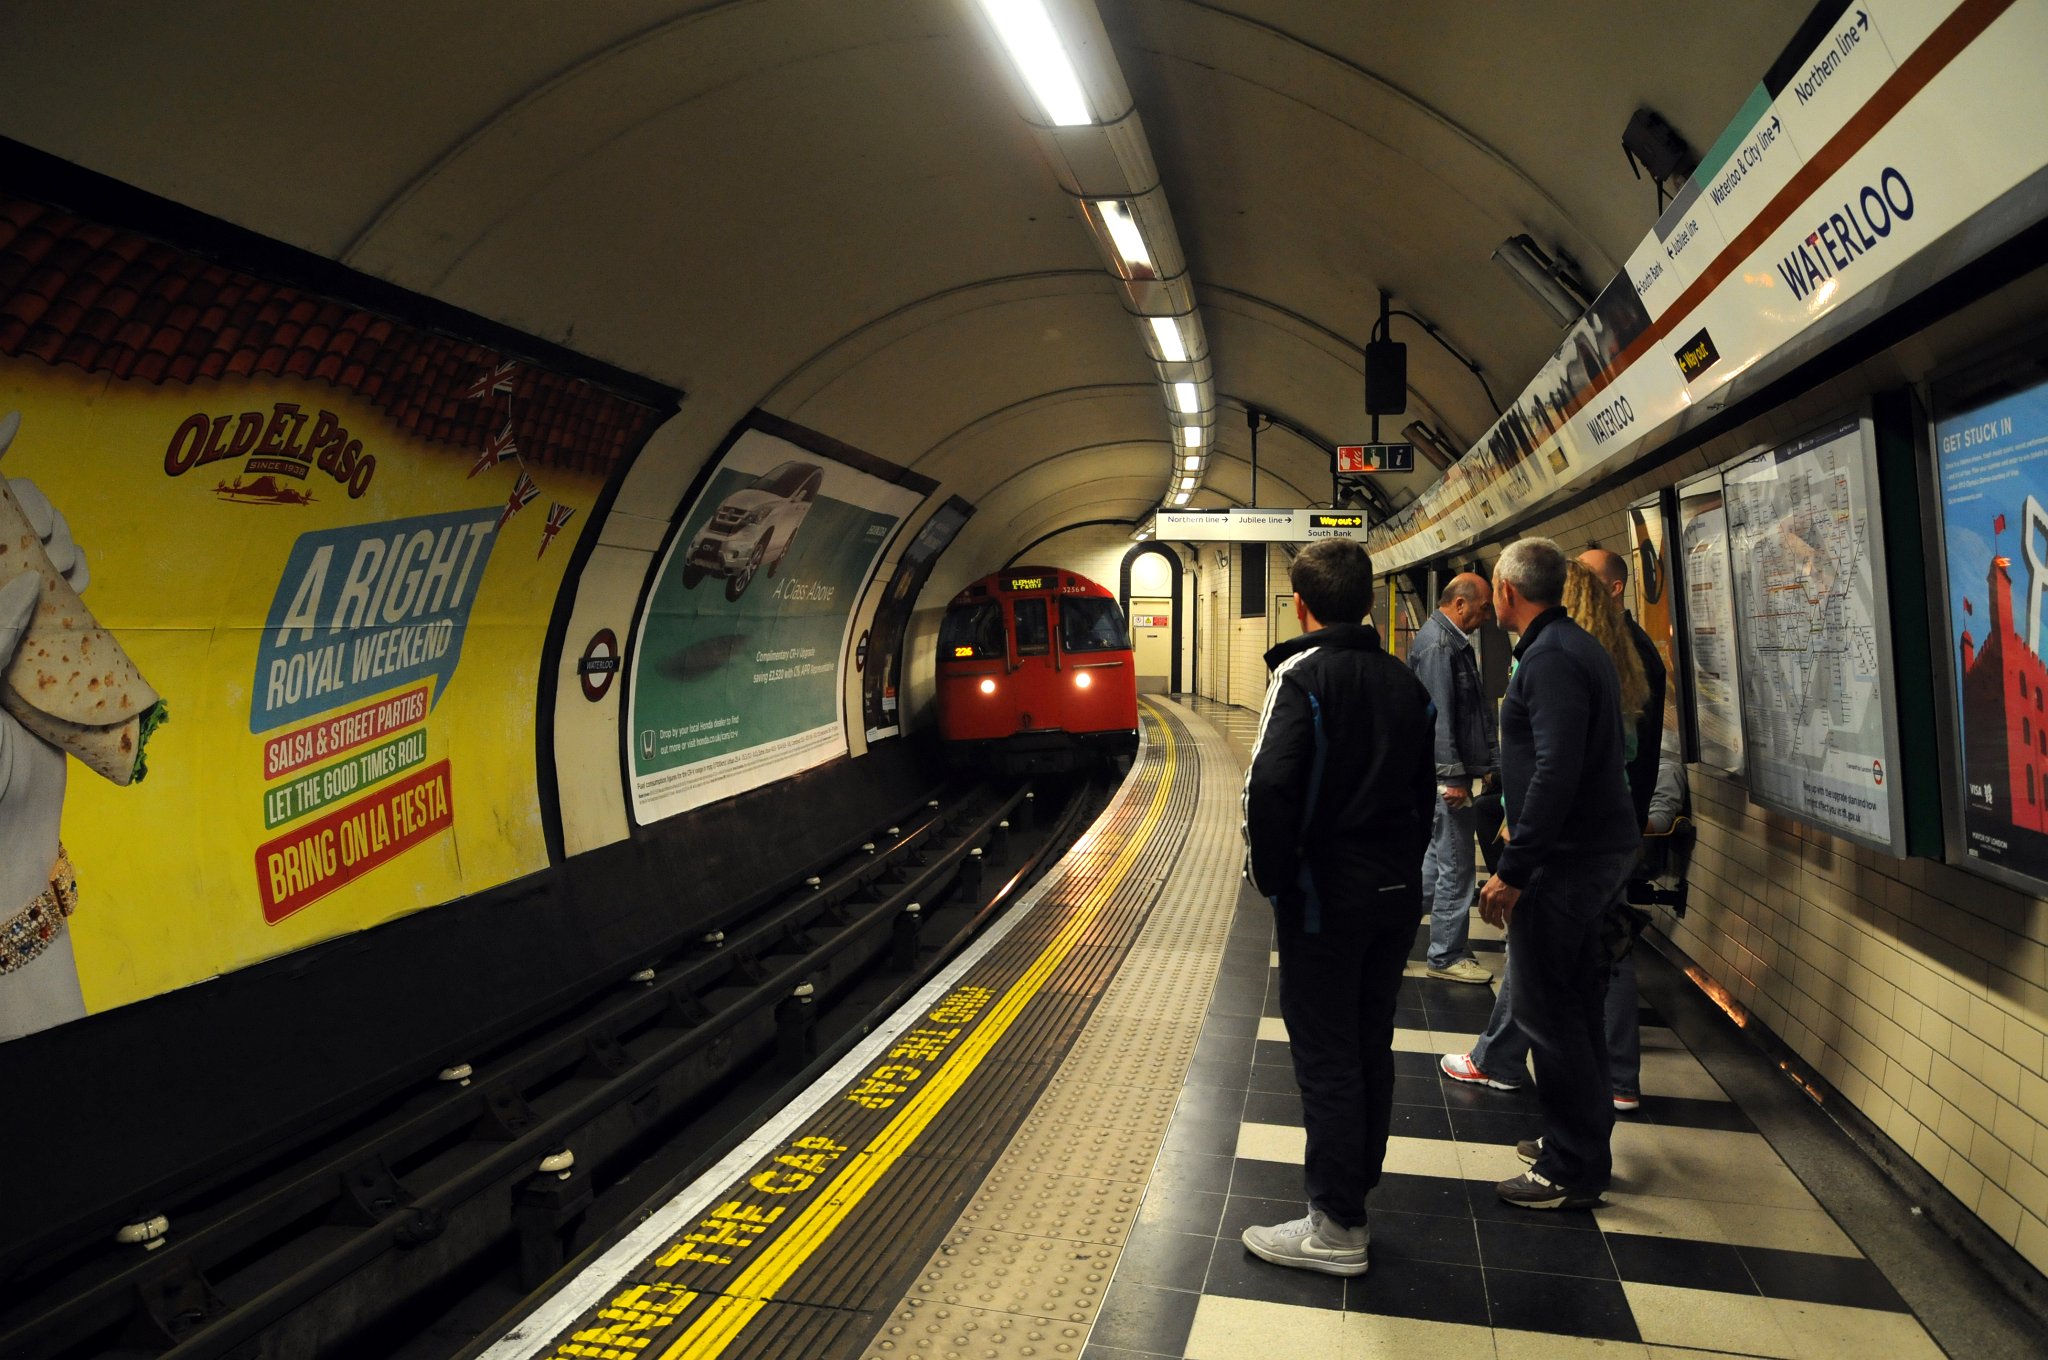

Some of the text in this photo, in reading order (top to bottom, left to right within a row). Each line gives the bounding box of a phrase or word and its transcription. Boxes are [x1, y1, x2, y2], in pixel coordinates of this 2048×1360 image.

[1794, 24, 1860, 107] Northern line
[1709, 124, 1776, 207] Waterloo & City line
[1671, 219, 1699, 256] Jubilee line
[1777, 166, 1914, 302] WATERLOO
[1639, 260, 1664, 293] South Bank
[1683, 341, 1709, 369] Way out
[164, 411, 264, 477] OLD
[251, 402, 309, 459] EL
[1586, 395, 1635, 446] WATERLOO
[1943, 433, 1962, 454] GET
[1964, 421, 1998, 448] STUCK
[2000, 416, 2012, 436] IN
[249, 461, 281, 470] SINCE
[1238, 516, 1267, 524] Jubilee
[1319, 516, 1338, 526] Way
[1337, 517, 1353, 526] out
[275, 519, 495, 649] A RIGHT
[772, 578, 835, 600] A Class Above
[265, 618, 453, 711] ROYAL WEEKEND
[586, 660, 614, 670] WATERLOO
[955, 647, 973, 657] 226
[268, 692, 424, 774] SALSA & STREET PARTIES
[660, 728, 671, 740] Drop
[671, 726, 679, 738] by
[678, 725, 690, 737] your
[689, 721, 700, 733] local
[699, 719, 714, 731] Honda
[660, 745, 670, 755] out
[669, 742, 682, 753] more
[268, 733, 425, 824] LET THE GOOD TIMES ROLL
[1969, 784, 1982, 796] VISA
[267, 775, 448, 905] BRING ON LA FIESTA
[545, 1135, 849, 1360] IND THE GAP
